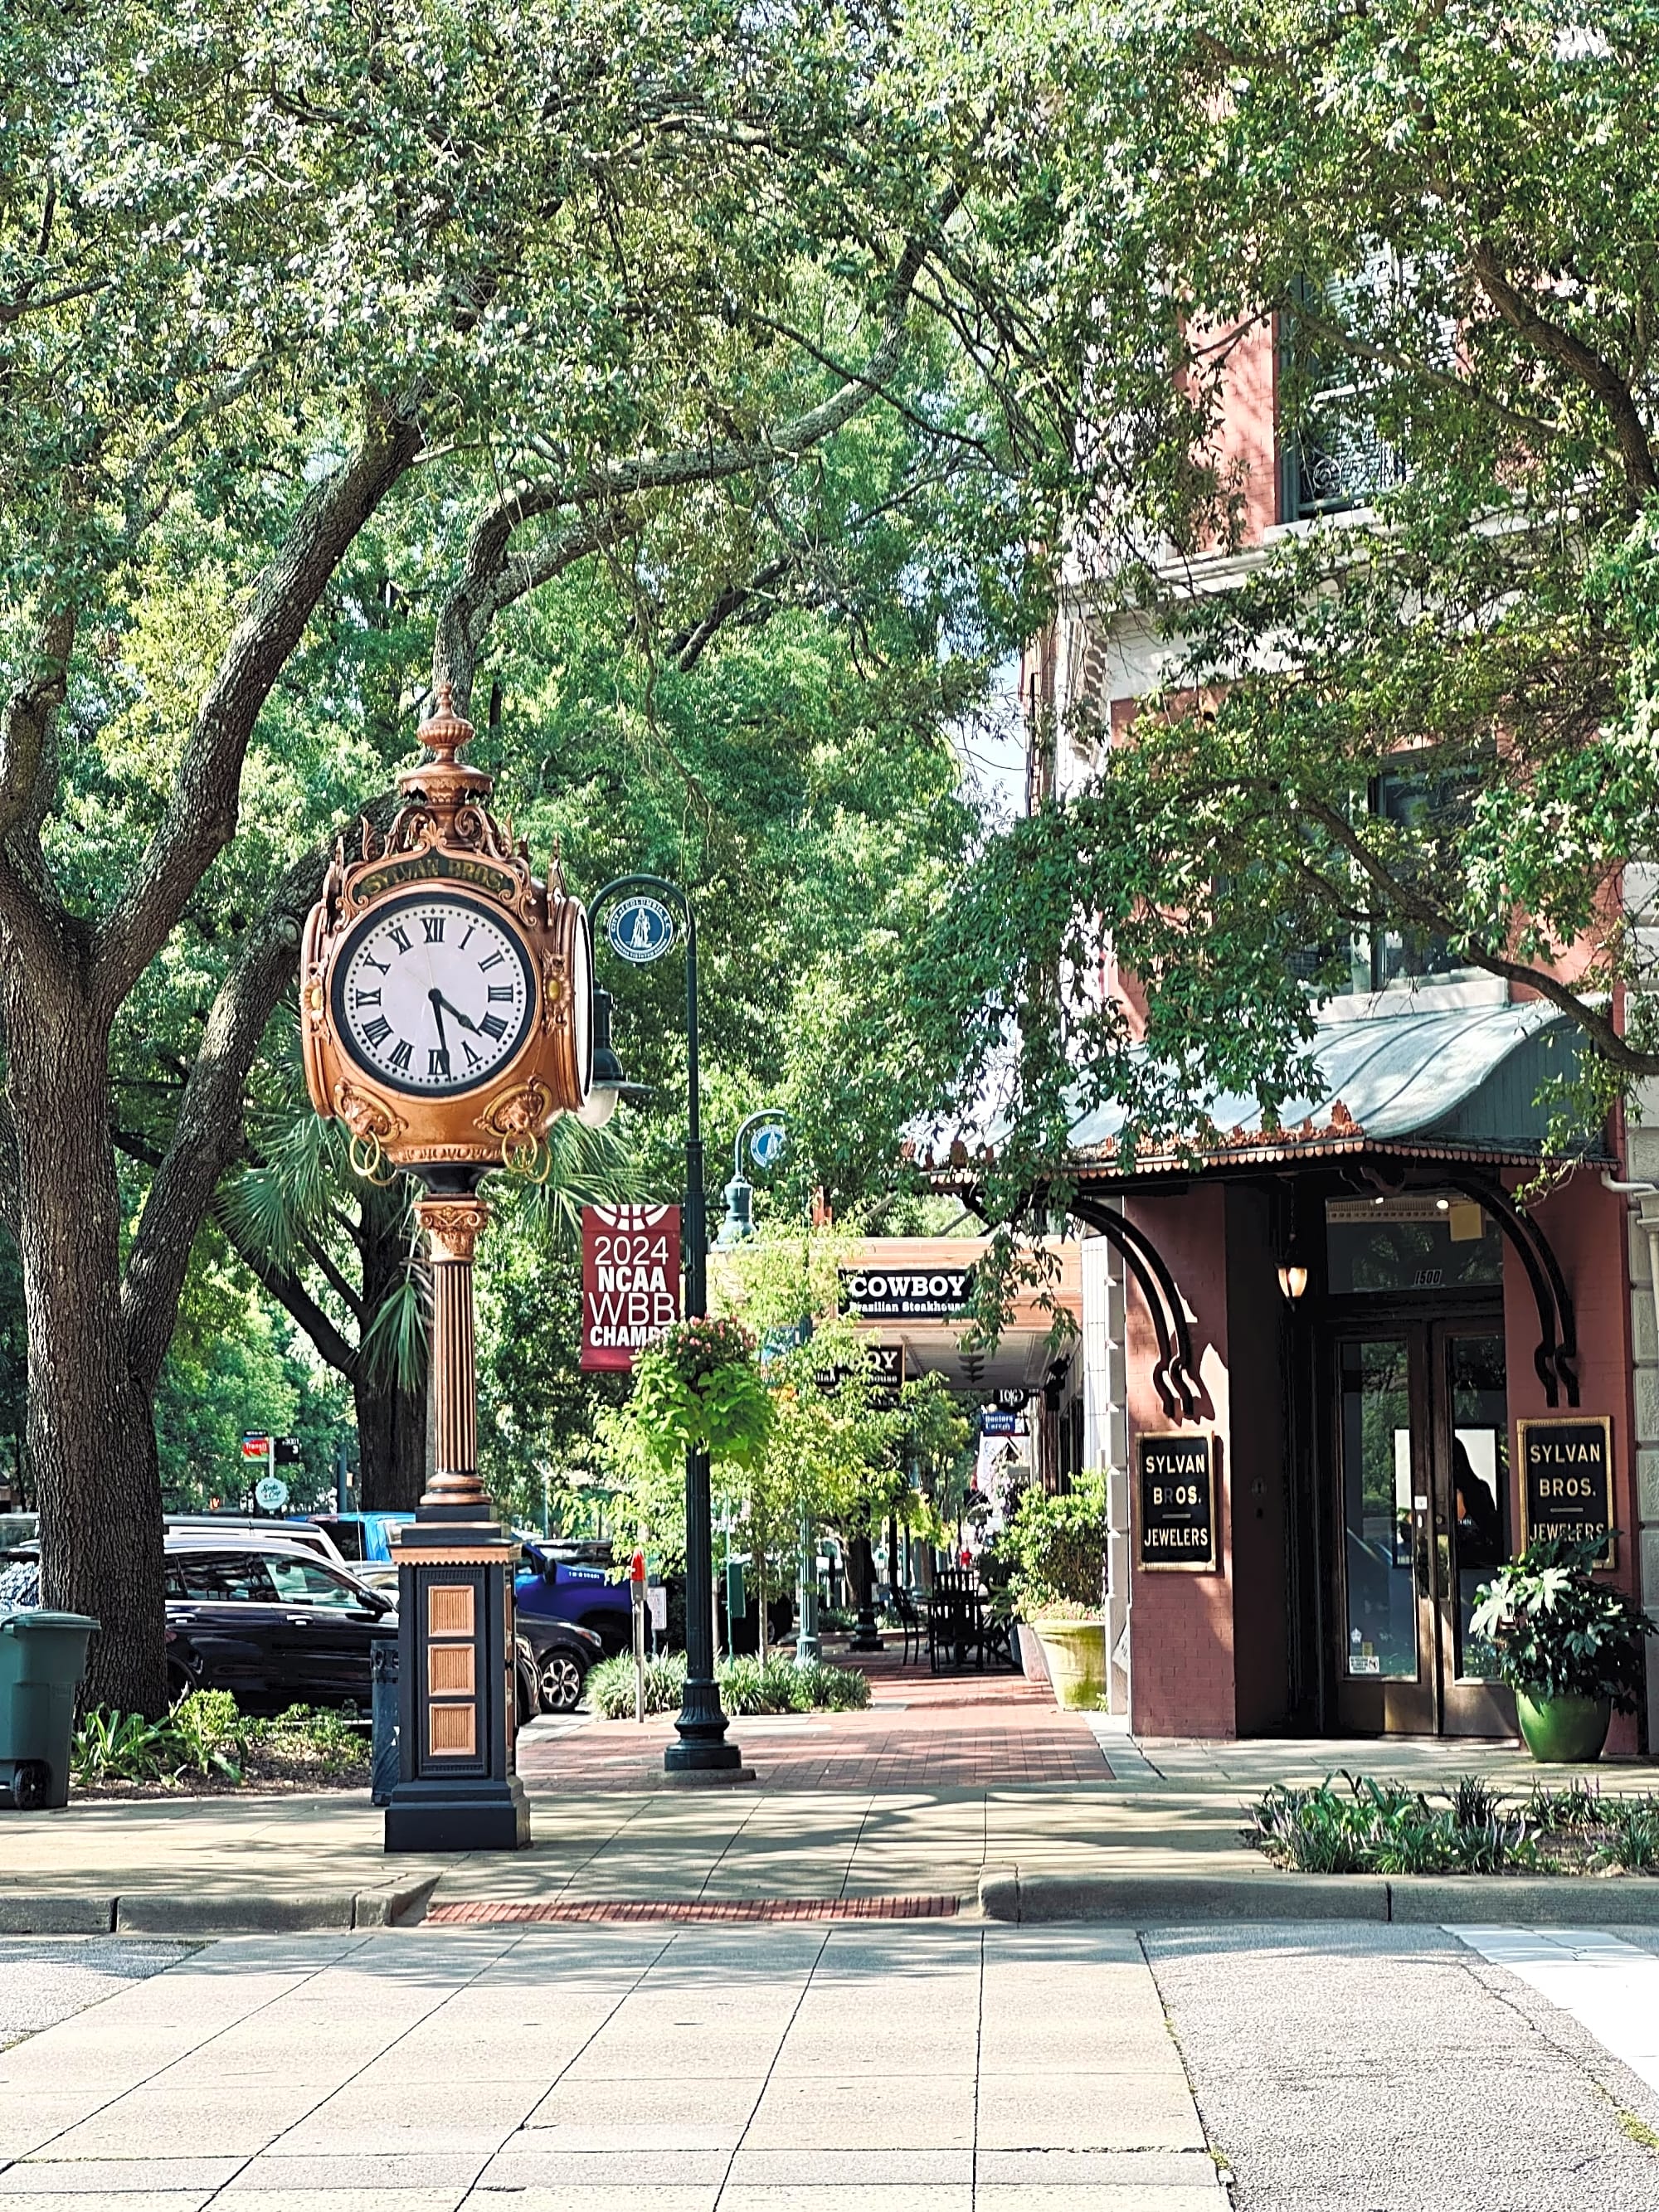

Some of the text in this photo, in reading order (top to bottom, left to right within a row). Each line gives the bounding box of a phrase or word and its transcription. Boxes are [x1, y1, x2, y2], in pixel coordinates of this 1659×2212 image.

[363, 858, 439, 893] SYLVAN
[386, 924, 414, 955] XI
[420, 916, 446, 944] XII
[362, 951, 391, 975] X
[356, 987, 382, 1009] IX
[461, 1039, 483, 1067] V
[594, 1236, 669, 1265] 2024
[598, 1266, 667, 1292] NCAA
[849, 1276, 966, 1297] COWBOY
[1414, 1270, 1442, 1286] 1500
[588, 1292, 676, 1326] WBB
[246, 1441, 267, 1451] Transit
[1530, 1443, 1600, 1463] SYLVAN
[1146, 1454, 1205, 1474] SYLVAN
[1153, 1485, 1201, 1505] BROS.
[1539, 1477, 1596, 1497] BROS.
[1144, 1528, 1208, 1547] JEWELERS
[1529, 1523, 1604, 1542] JEWELERS
